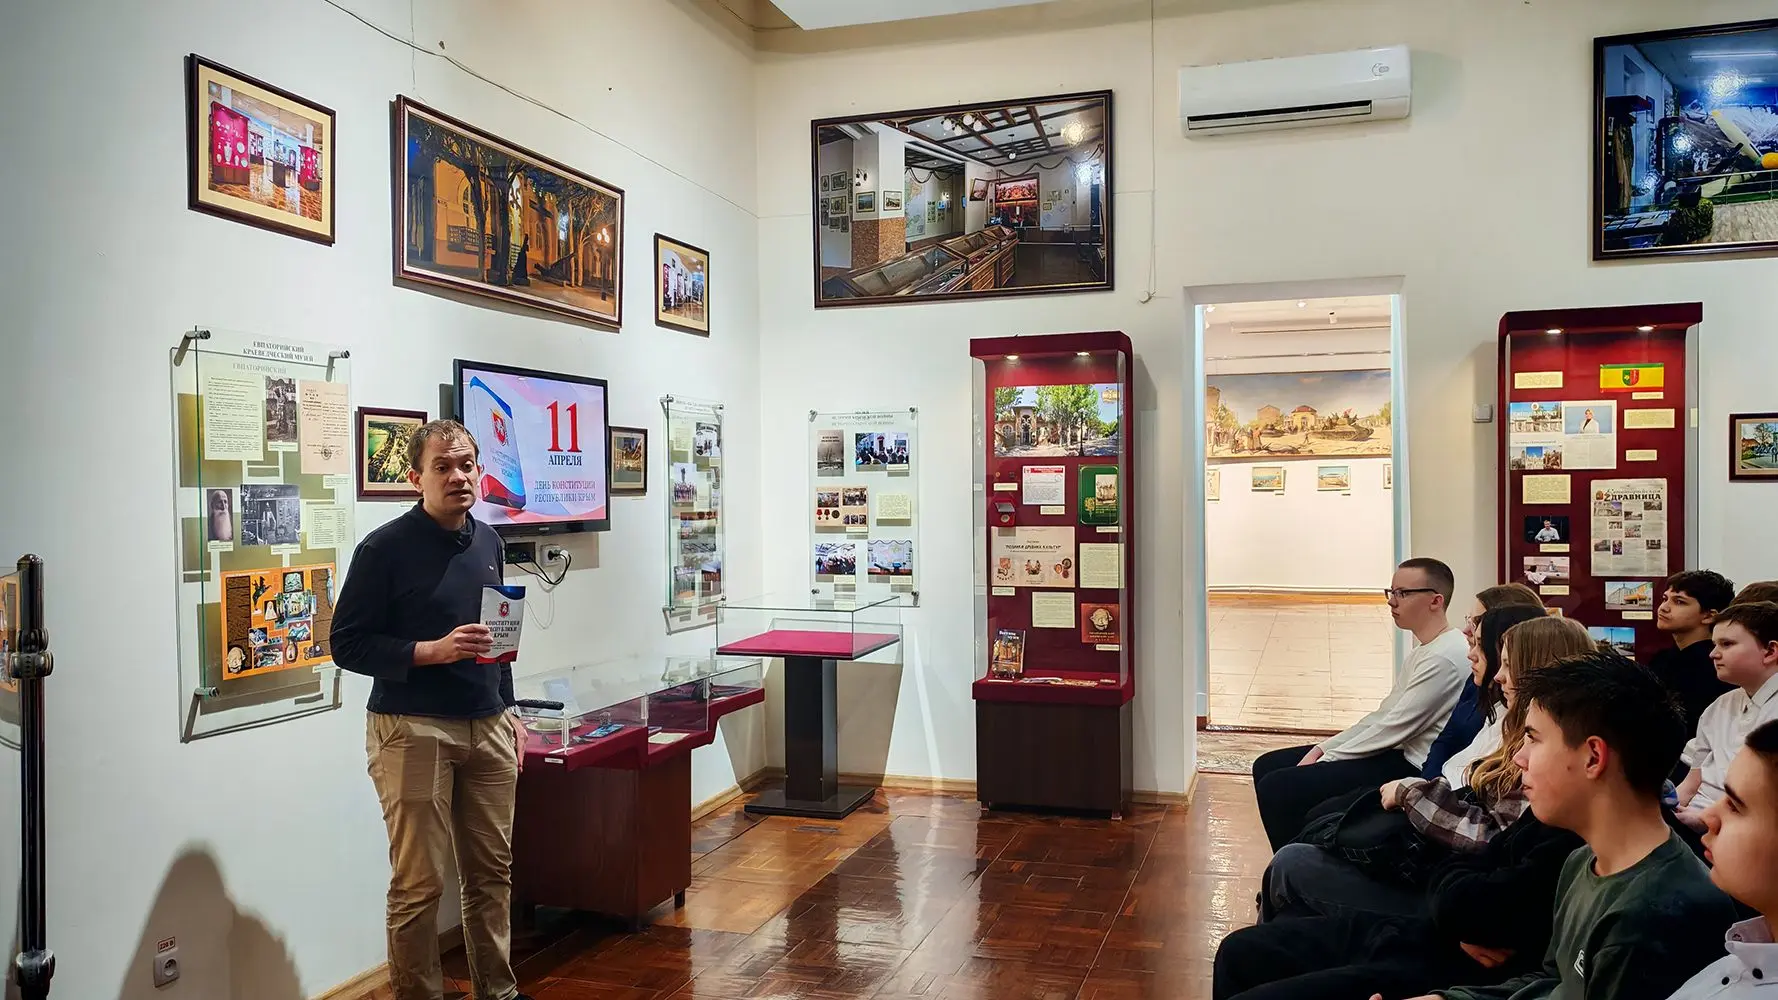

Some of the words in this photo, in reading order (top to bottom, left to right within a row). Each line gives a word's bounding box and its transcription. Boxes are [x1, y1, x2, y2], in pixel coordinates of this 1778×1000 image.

[546, 400, 582, 453] 11
[548, 455, 582, 466] АПРЕЛЯ
[534, 480, 551, 490] ДЕНЬ
[552, 480, 596, 490] КОНСТИТУЦИИ
[534, 493, 577, 503] РЕСПУБЛИКИ
[578, 493, 596, 502] КРЫМ
